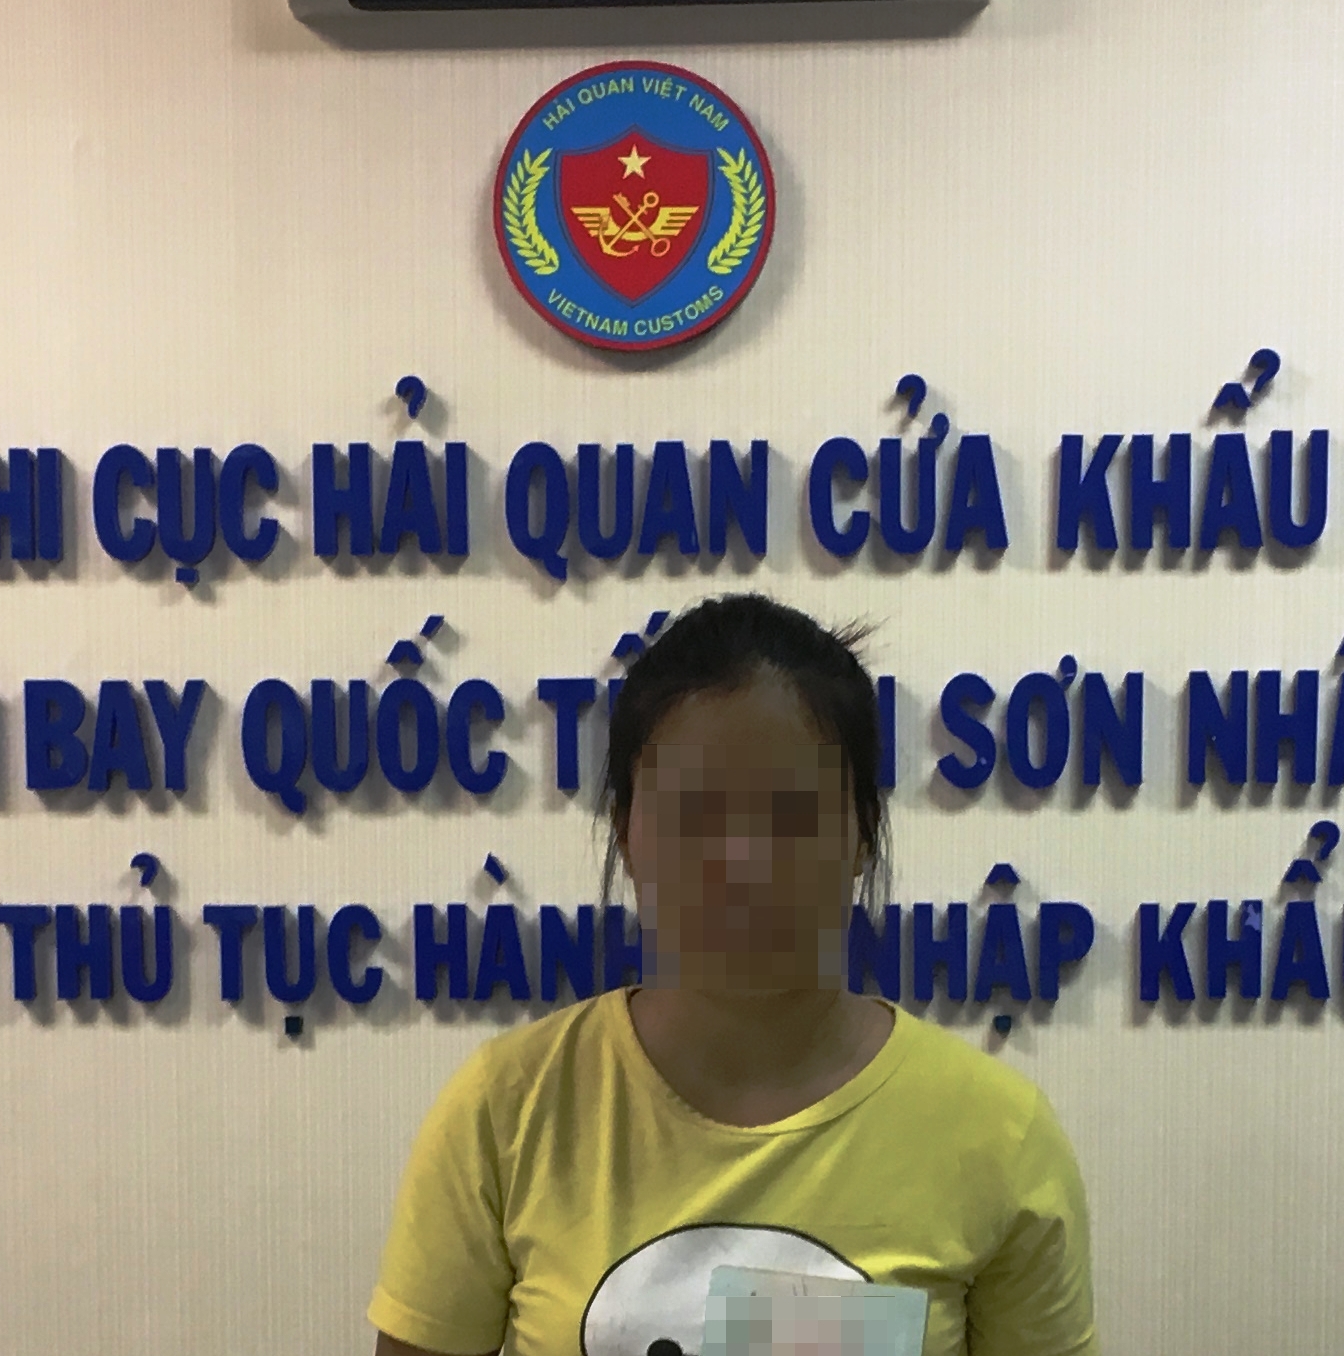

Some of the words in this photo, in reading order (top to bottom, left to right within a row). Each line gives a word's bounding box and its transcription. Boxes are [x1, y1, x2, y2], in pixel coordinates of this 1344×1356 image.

[578, 77, 635, 106] QUAN
[642, 76, 688, 100] VIỆT
[688, 93, 730, 132] NAM
[547, 288, 628, 336] VIETNAM
[633, 285, 724, 336] CUSTOMS
[94, 445, 278, 582] CỤC
[313, 377, 468, 555] HẢI
[506, 440, 768, 578] QUAN
[810, 375, 1008, 555] CỬA
[1057, 349, 1329, 549] KHẨU
[24, 680, 203, 790] BAY
[242, 616, 506, 812] QUỐC
[539, 613, 665, 788] T
[939, 656, 1143, 788] SƠN
[204, 906, 381, 1036] TỤC
